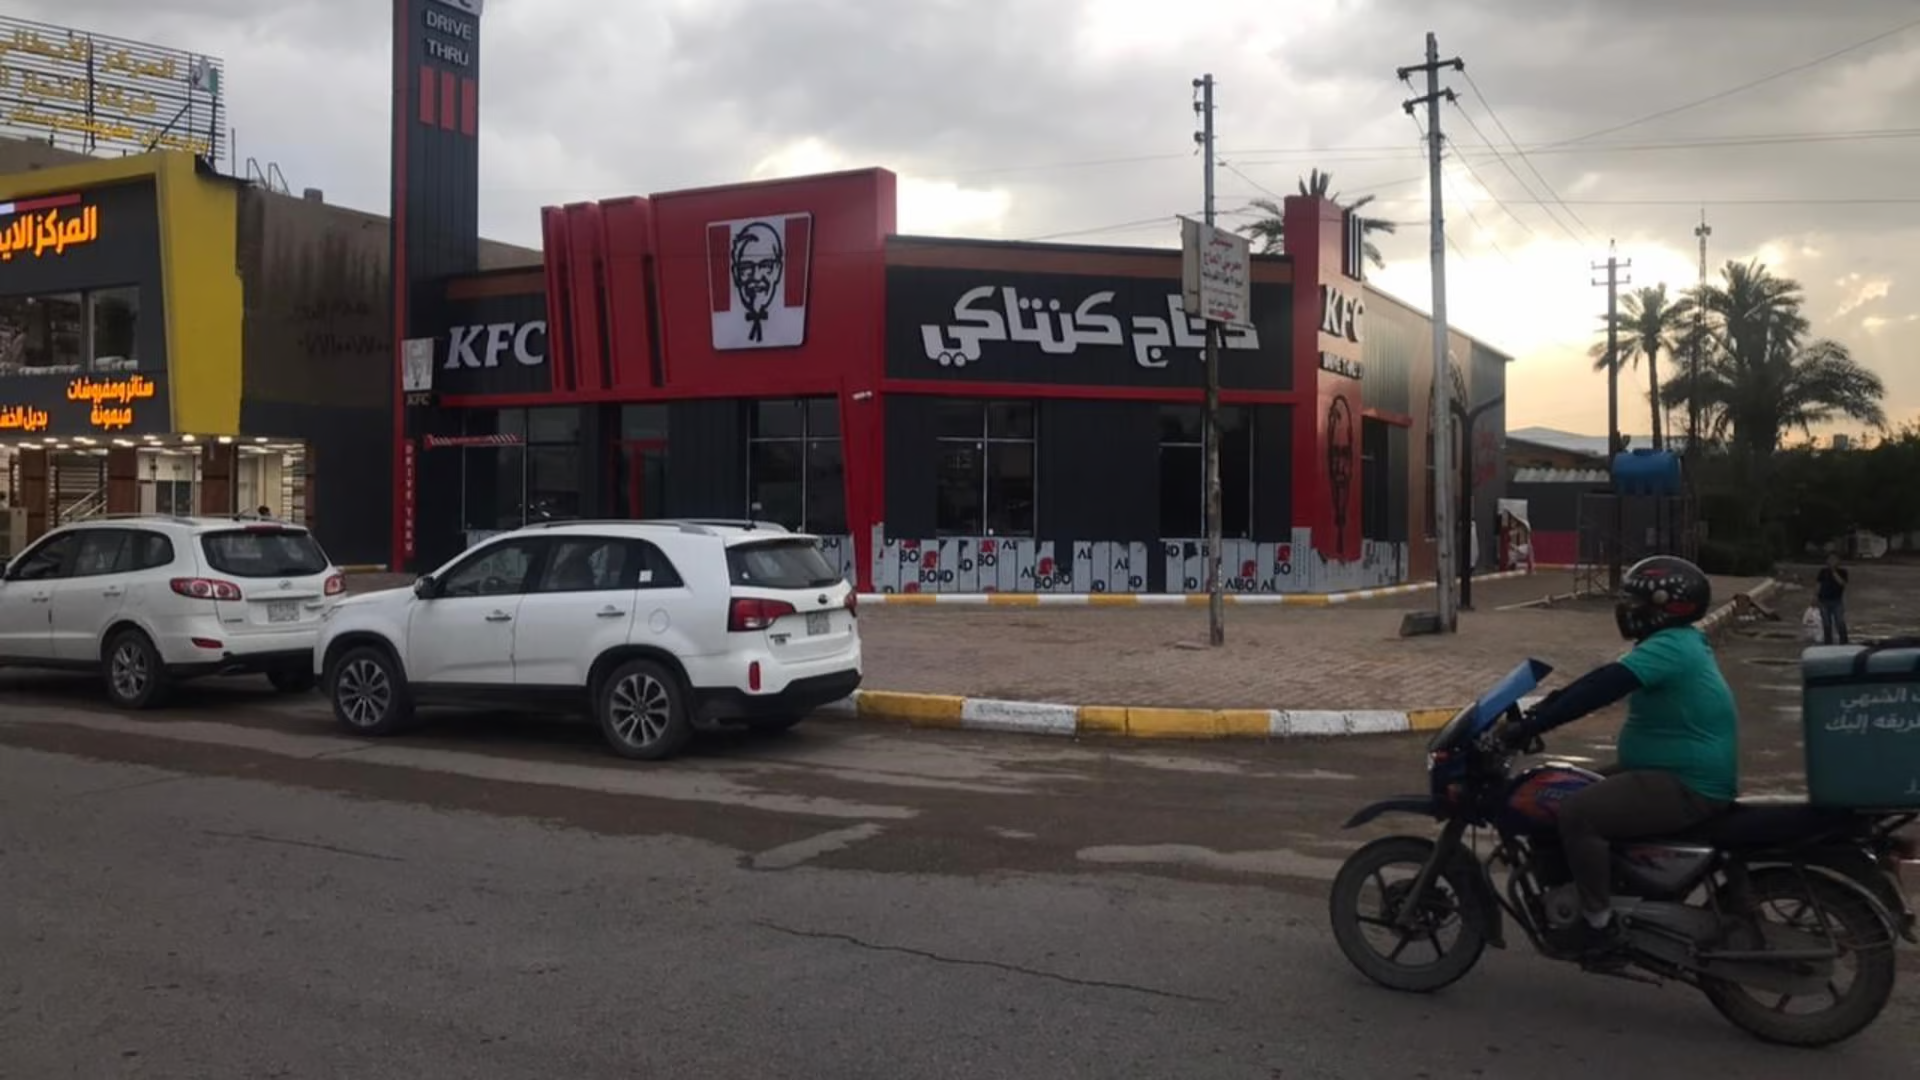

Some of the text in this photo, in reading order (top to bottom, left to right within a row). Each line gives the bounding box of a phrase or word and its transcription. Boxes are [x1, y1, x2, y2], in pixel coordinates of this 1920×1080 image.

[426, 9, 472, 41] DRIVE
[427, 37, 470, 66] THRU
[0, 204, 97, 259] المركز الاي
[920, 285, 1124, 367] كنتاكي
[1322, 286, 1366, 343] KFC
[443, 320, 547, 370] KFC
[406, 393, 431, 406] KFC
[0, 404, 48, 431] بديل الخش
[1824, 713, 1920, 735] ريقه إليك
